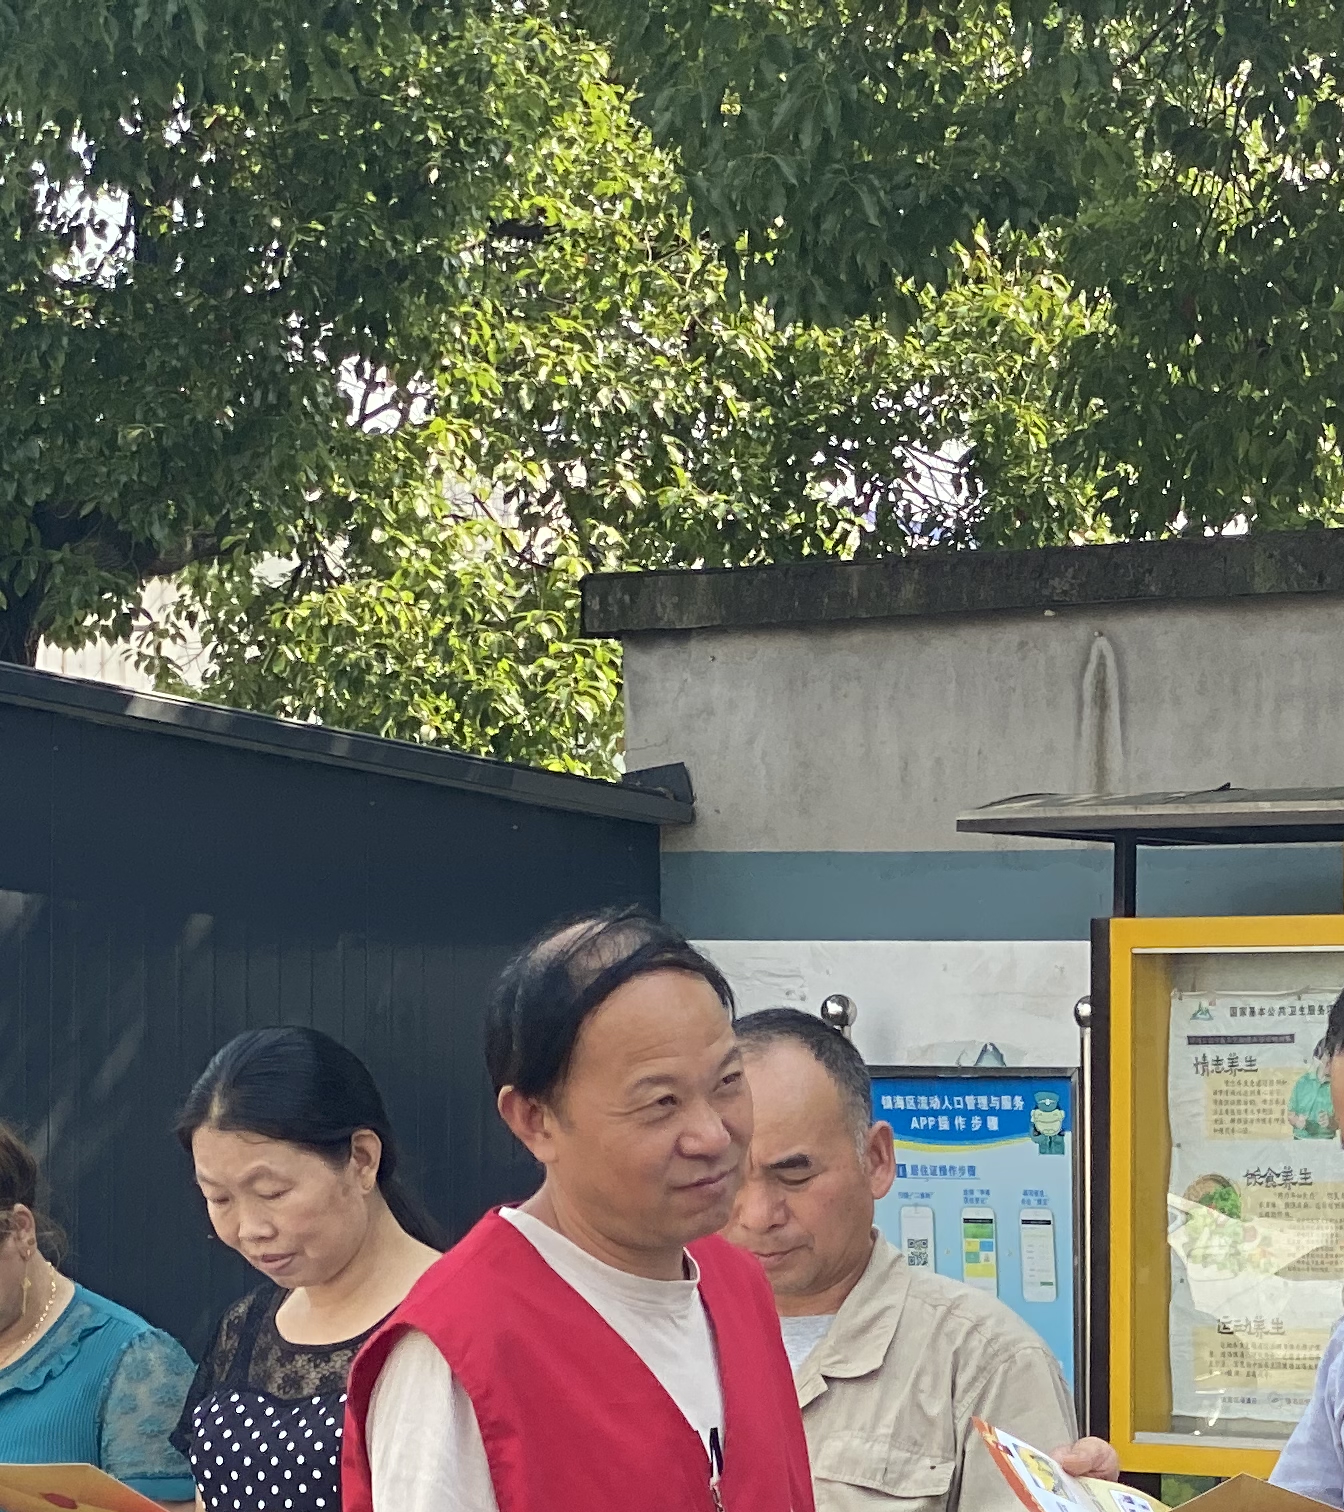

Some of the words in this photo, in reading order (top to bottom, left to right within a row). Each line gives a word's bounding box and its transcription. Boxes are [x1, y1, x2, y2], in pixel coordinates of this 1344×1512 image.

[881, 1095, 1025, 1111] 镇海区流动人口管理与服务
